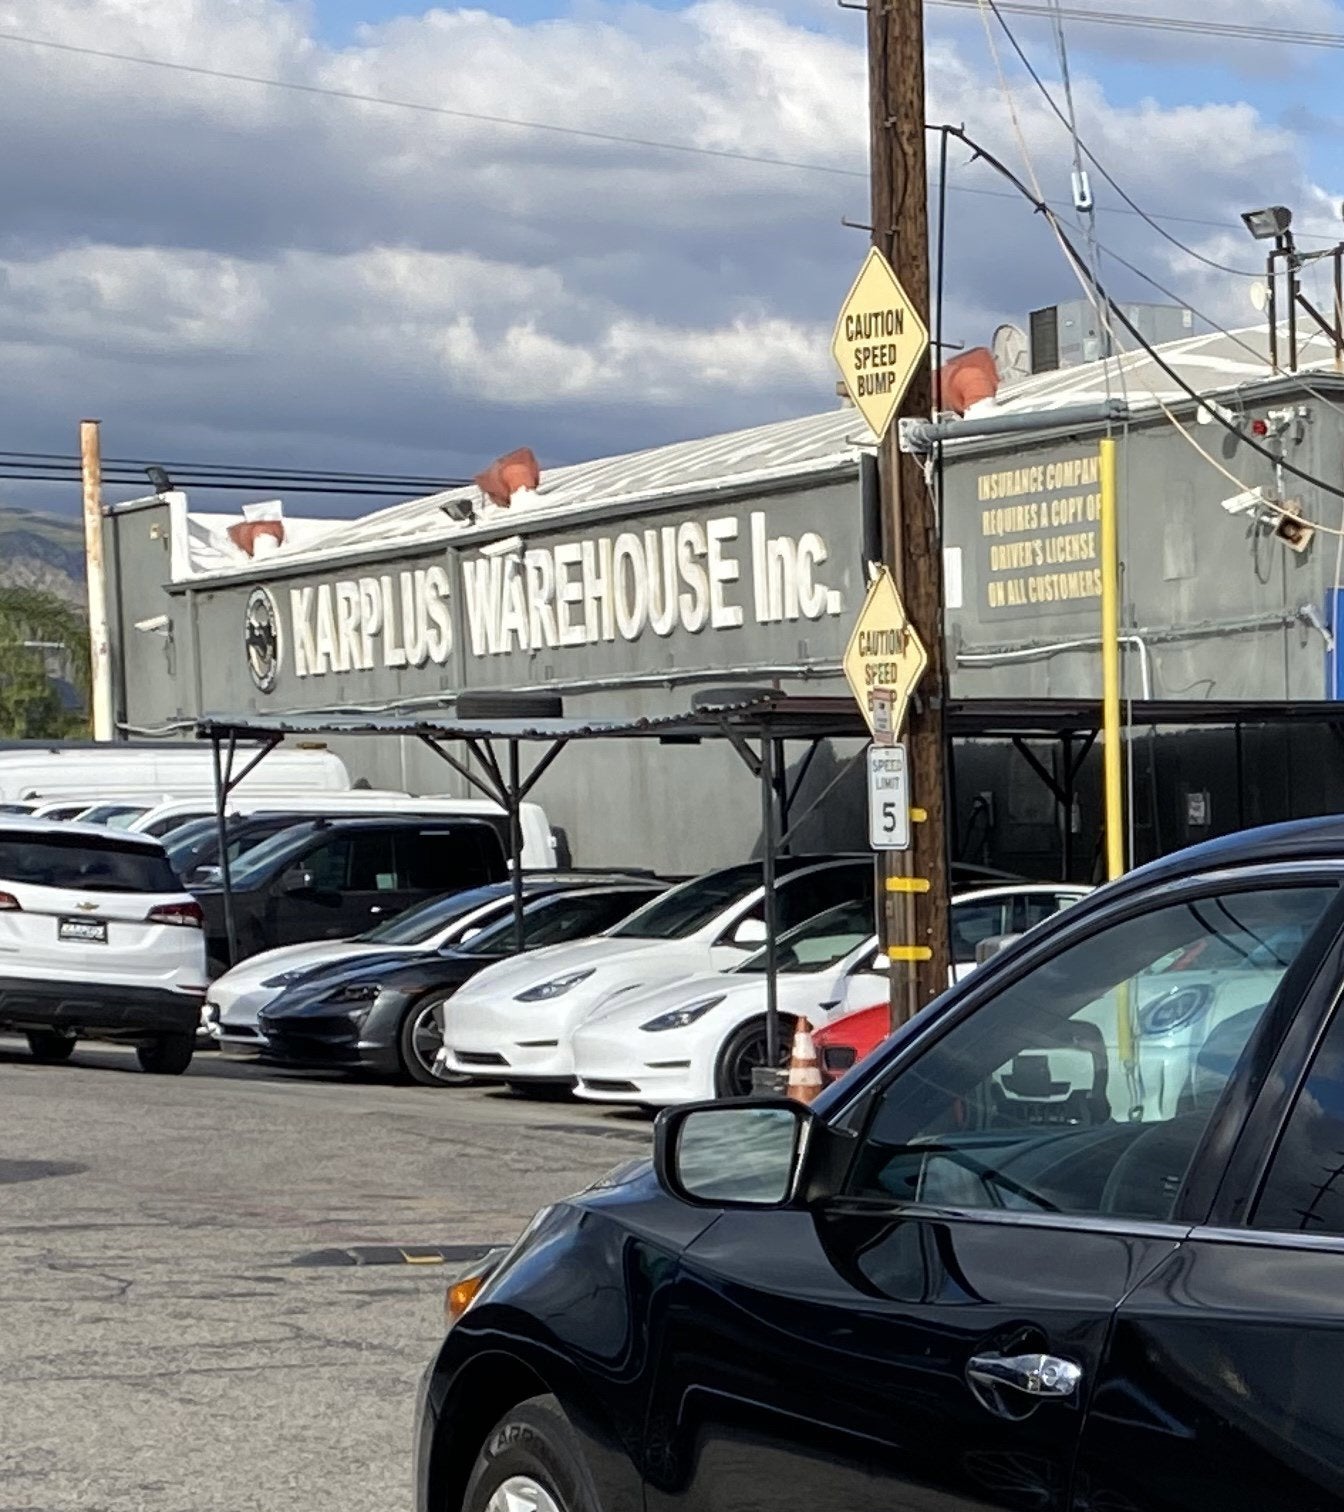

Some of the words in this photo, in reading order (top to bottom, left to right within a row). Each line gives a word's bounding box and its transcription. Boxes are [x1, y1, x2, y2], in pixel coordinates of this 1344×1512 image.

[845, 308, 905, 343] CAUTION
[853, 343, 898, 371] SPEED
[856, 370, 897, 398] BUMP
[977, 465, 1044, 501] INSURANCE
[1045, 456, 1101, 491] COMPAN
[982, 502, 1039, 537] REQUIRES
[1040, 501, 1049, 529] A
[1051, 495, 1084, 528] COPY
[990, 538, 1043, 571] DRIVER'S
[1045, 531, 1097, 564] LICENSE
[289, 565, 451, 678] KARPLUS
[462, 516, 744, 657] WAREHOUSE
[750, 511, 842, 624] Inc.
[988, 580, 1005, 608] ON
[1007, 578, 1028, 606] ALL
[1028, 568, 1102, 603] CUSTOMERS
[859, 627, 904, 657] CAUTION
[865, 662, 898, 685] SPEED
[867, 688, 898, 711] BP
[872, 759, 902, 773] SPEED
[882, 801, 897, 833] 5
